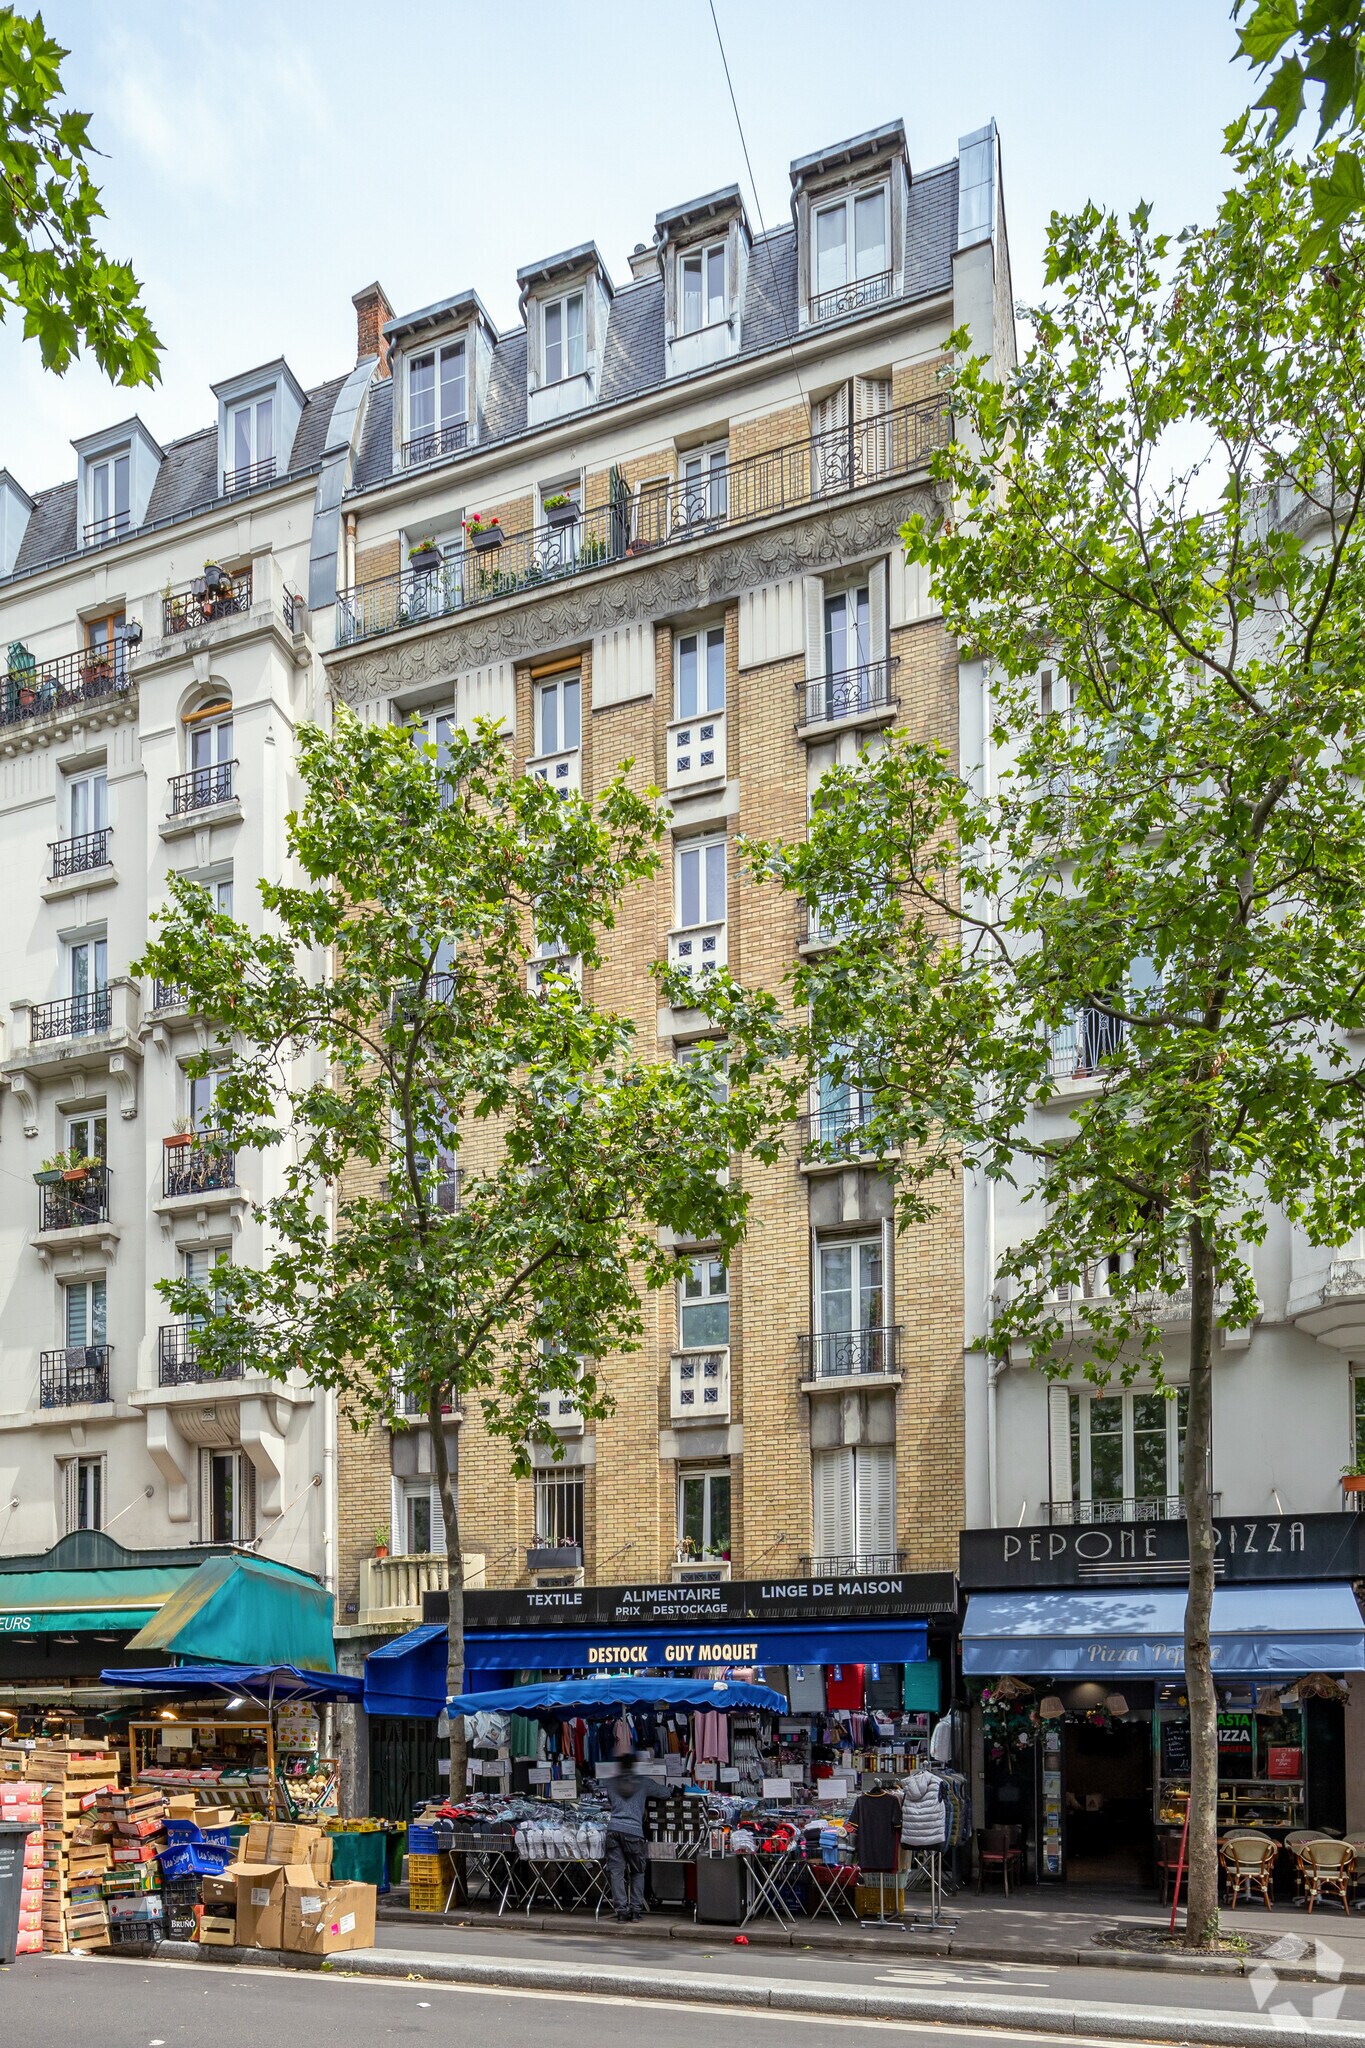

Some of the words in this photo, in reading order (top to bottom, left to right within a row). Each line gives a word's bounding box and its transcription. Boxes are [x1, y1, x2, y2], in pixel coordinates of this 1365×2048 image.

[1003, 1528, 1157, 1562] PEPONE
[622, 1588, 721, 1603] ALIMENTAIRE
[761, 1584, 808, 1598] LINGE
[812, 1583, 834, 1596] DE
[838, 1581, 903, 1595] MAISON
[526, 1593, 583, 1606] TEXTILE
[615, 1606, 641, 1616] PRIX
[652, 1603, 728, 1615] DESTOCKAGE
[588, 1646, 648, 1663] DESTOCK
[664, 1645, 695, 1661] GUY
[698, 1643, 758, 1661] MOQUET
[1087, 1643, 1139, 1662] Pizza
[1152, 1642, 1222, 1668] Pepe
[1217, 1714, 1250, 1726] ASTA
[1216, 1729, 1250, 1742] IZZA
